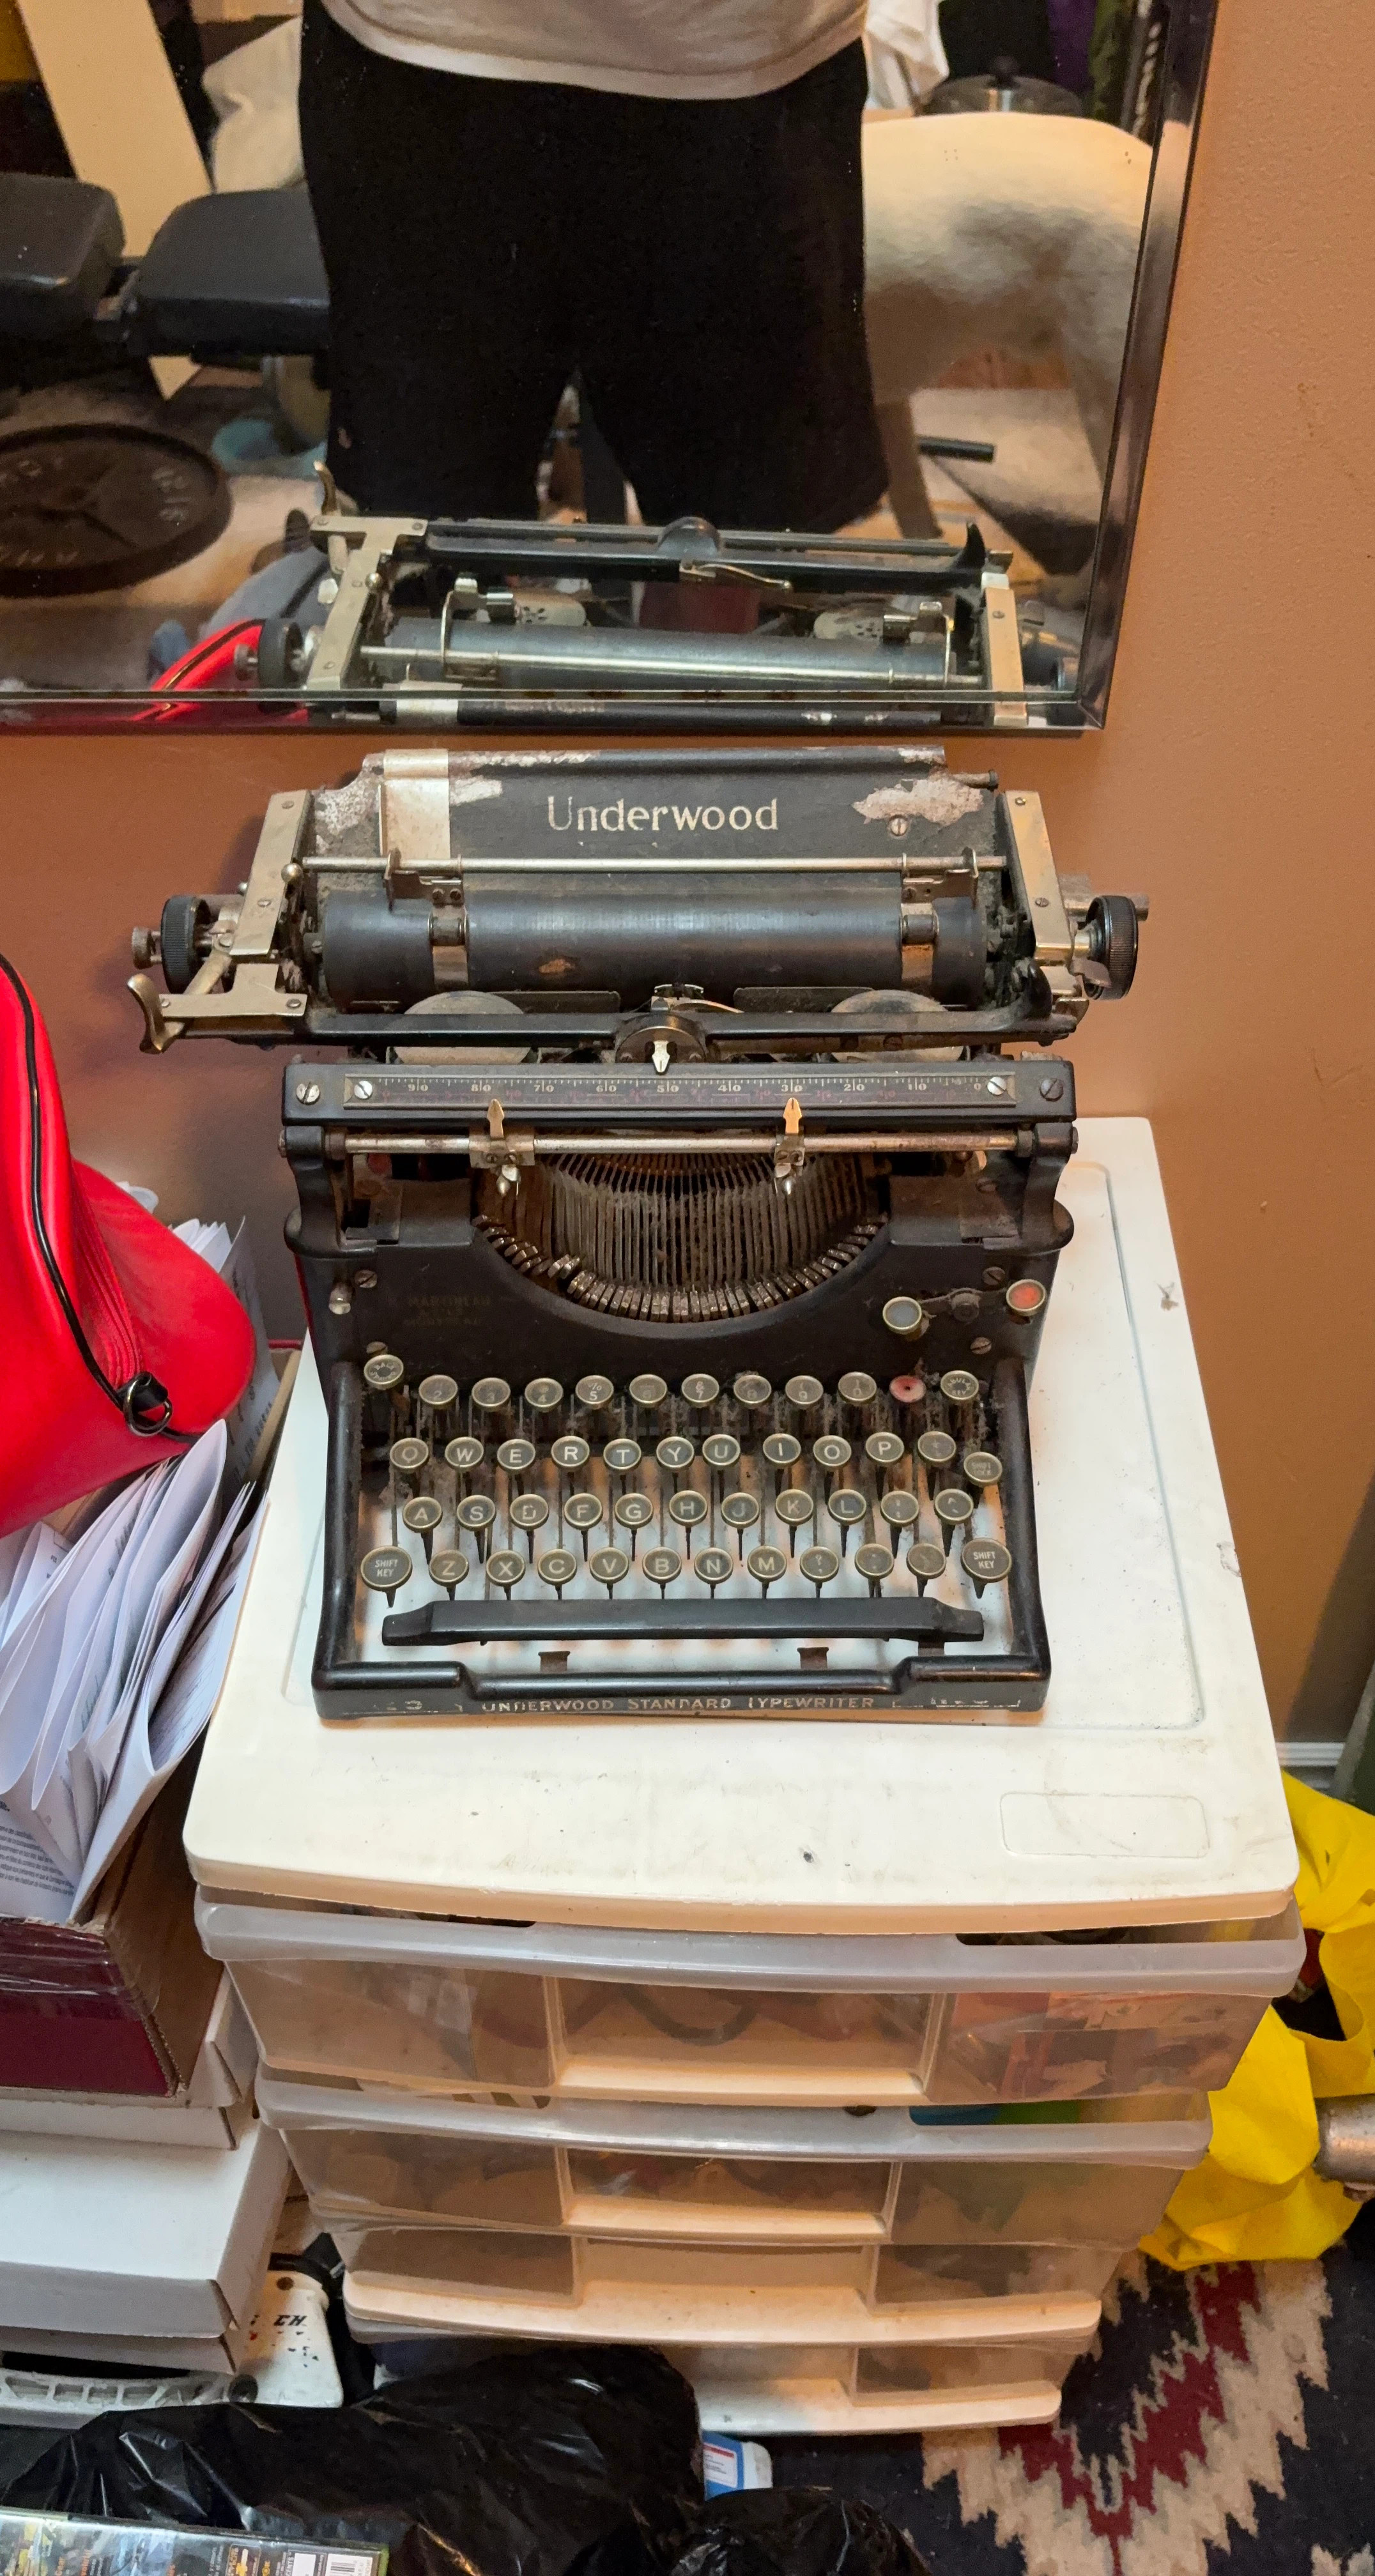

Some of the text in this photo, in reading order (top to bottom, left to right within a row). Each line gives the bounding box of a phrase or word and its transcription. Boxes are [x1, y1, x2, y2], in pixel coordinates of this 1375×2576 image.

[548, 796, 778, 831] Underwood
[590, 1391, 598, 1400] 5
[457, 1448, 474, 1462] W
[509, 1448, 522, 1463] E
[564, 1446, 578, 1460] R
[667, 1446, 681, 1462] Y
[714, 1445, 728, 1459] U
[778, 1443, 783, 1457] I
[824, 1445, 840, 1460] O
[878, 1441, 891, 1455] P
[616, 1449, 630, 1464] T
[413, 1507, 428, 1521] A
[469, 1506, 484, 1521] S
[576, 1505, 588, 1519] F
[626, 1504, 641, 1519] G
[679, 1501, 694, 1516] H
[732, 1503, 745, 1518] J
[787, 1499, 799, 1515] K
[840, 1499, 854, 1514] L
[973, 1551, 995, 1560] SHIFT
[374, 1559, 399, 1568] SHIFT
[442, 1561, 455, 1576] Z
[498, 1561, 513, 1577] X
[549, 1559, 565, 1574] C
[603, 1559, 617, 1574] V
[655, 1558, 670, 1573] B
[707, 1559, 721, 1574] N
[758, 1557, 775, 1571] M
[978, 1560, 995, 1569] KEY
[376, 1568, 394, 1577] KEY
[482, 1699, 615, 1712] UNDERWOOD
[627, 1698, 732, 1710] STANDARD
